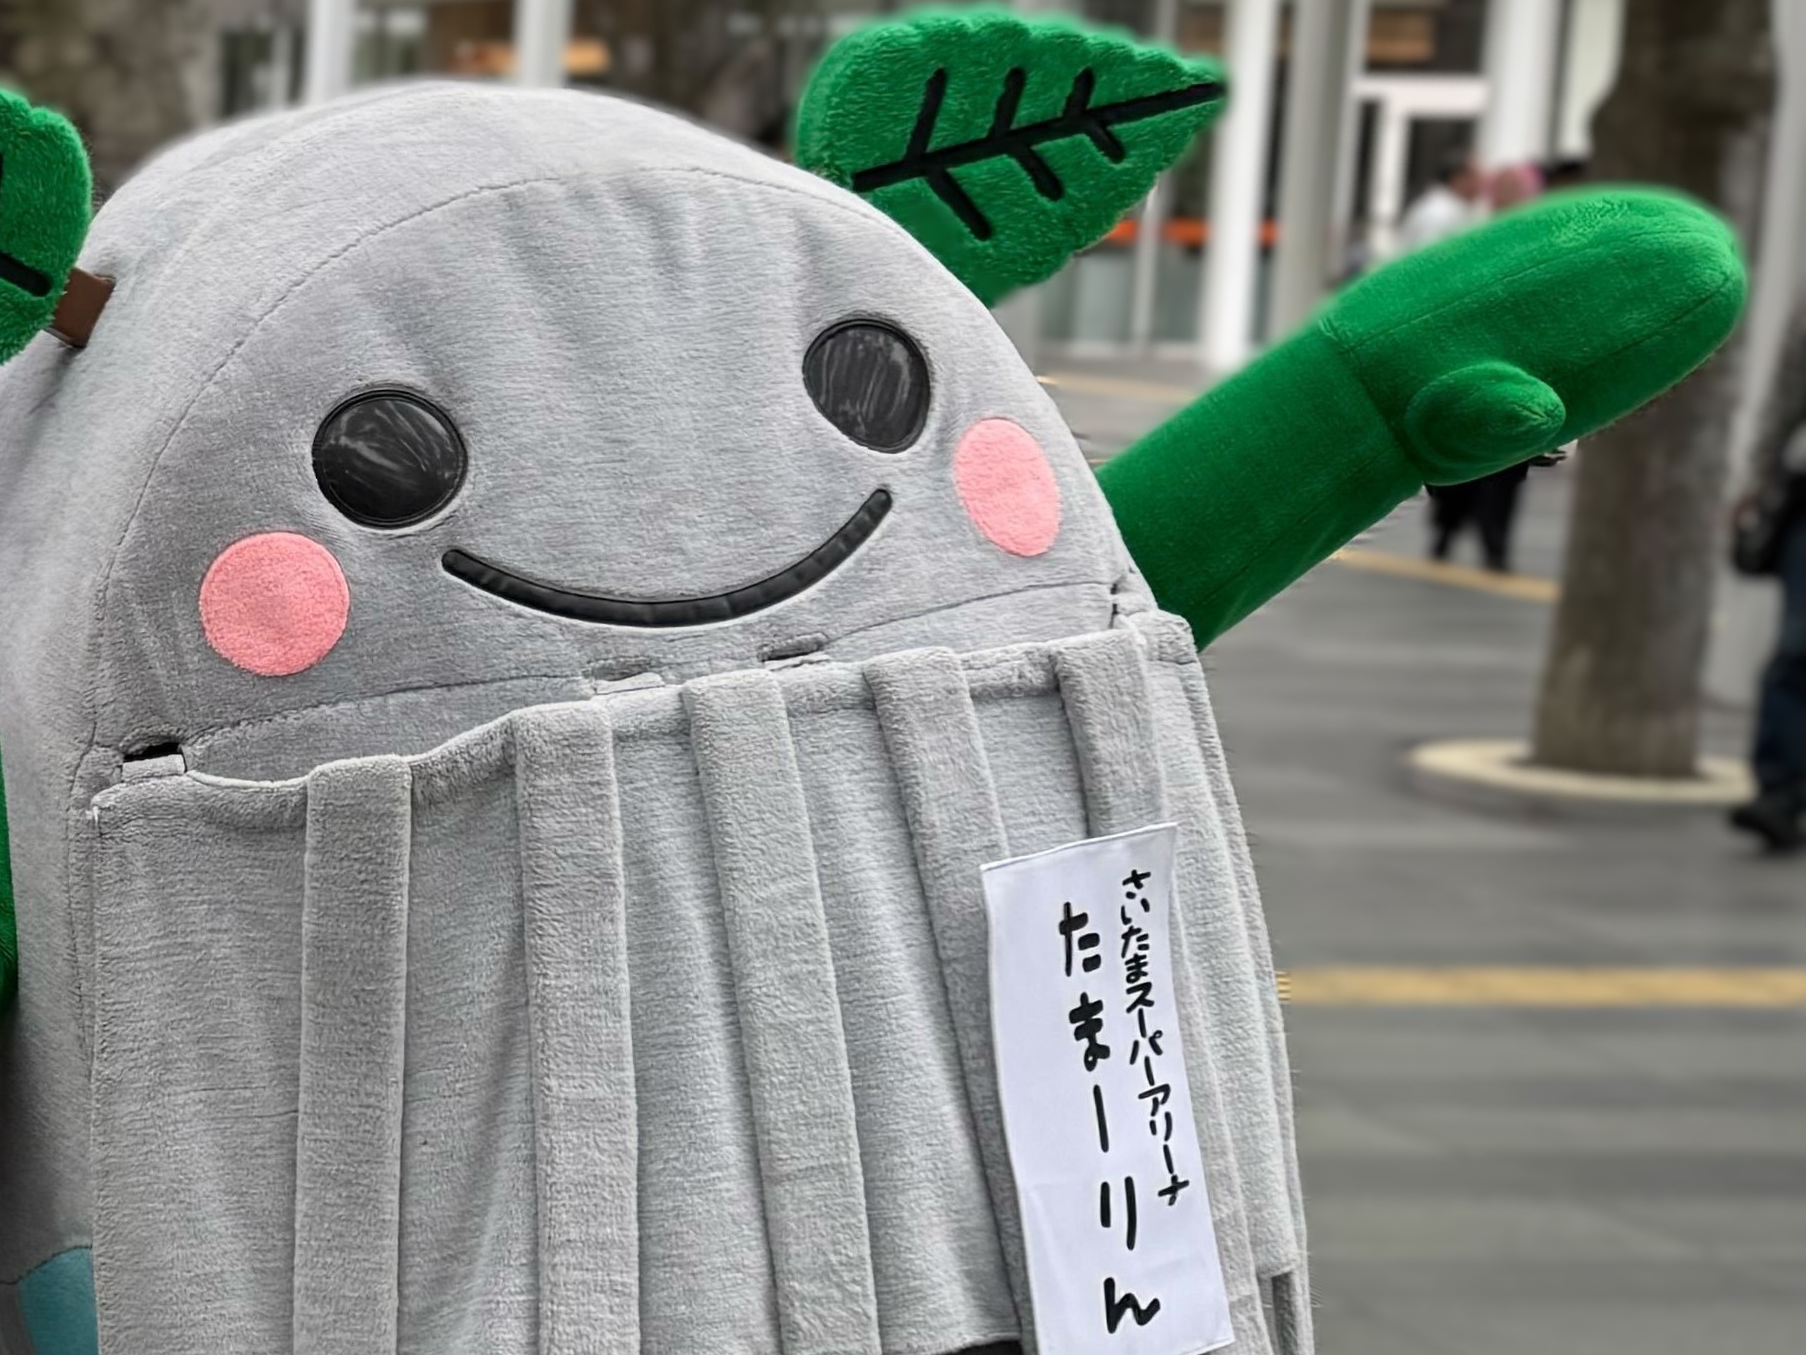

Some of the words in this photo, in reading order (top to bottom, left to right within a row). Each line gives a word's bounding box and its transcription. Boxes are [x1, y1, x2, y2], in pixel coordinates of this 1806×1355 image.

[1058, 901, 1160, 1334] たまーりん
[1120, 869, 1190, 1206] さいたまスーパーアリーナ
